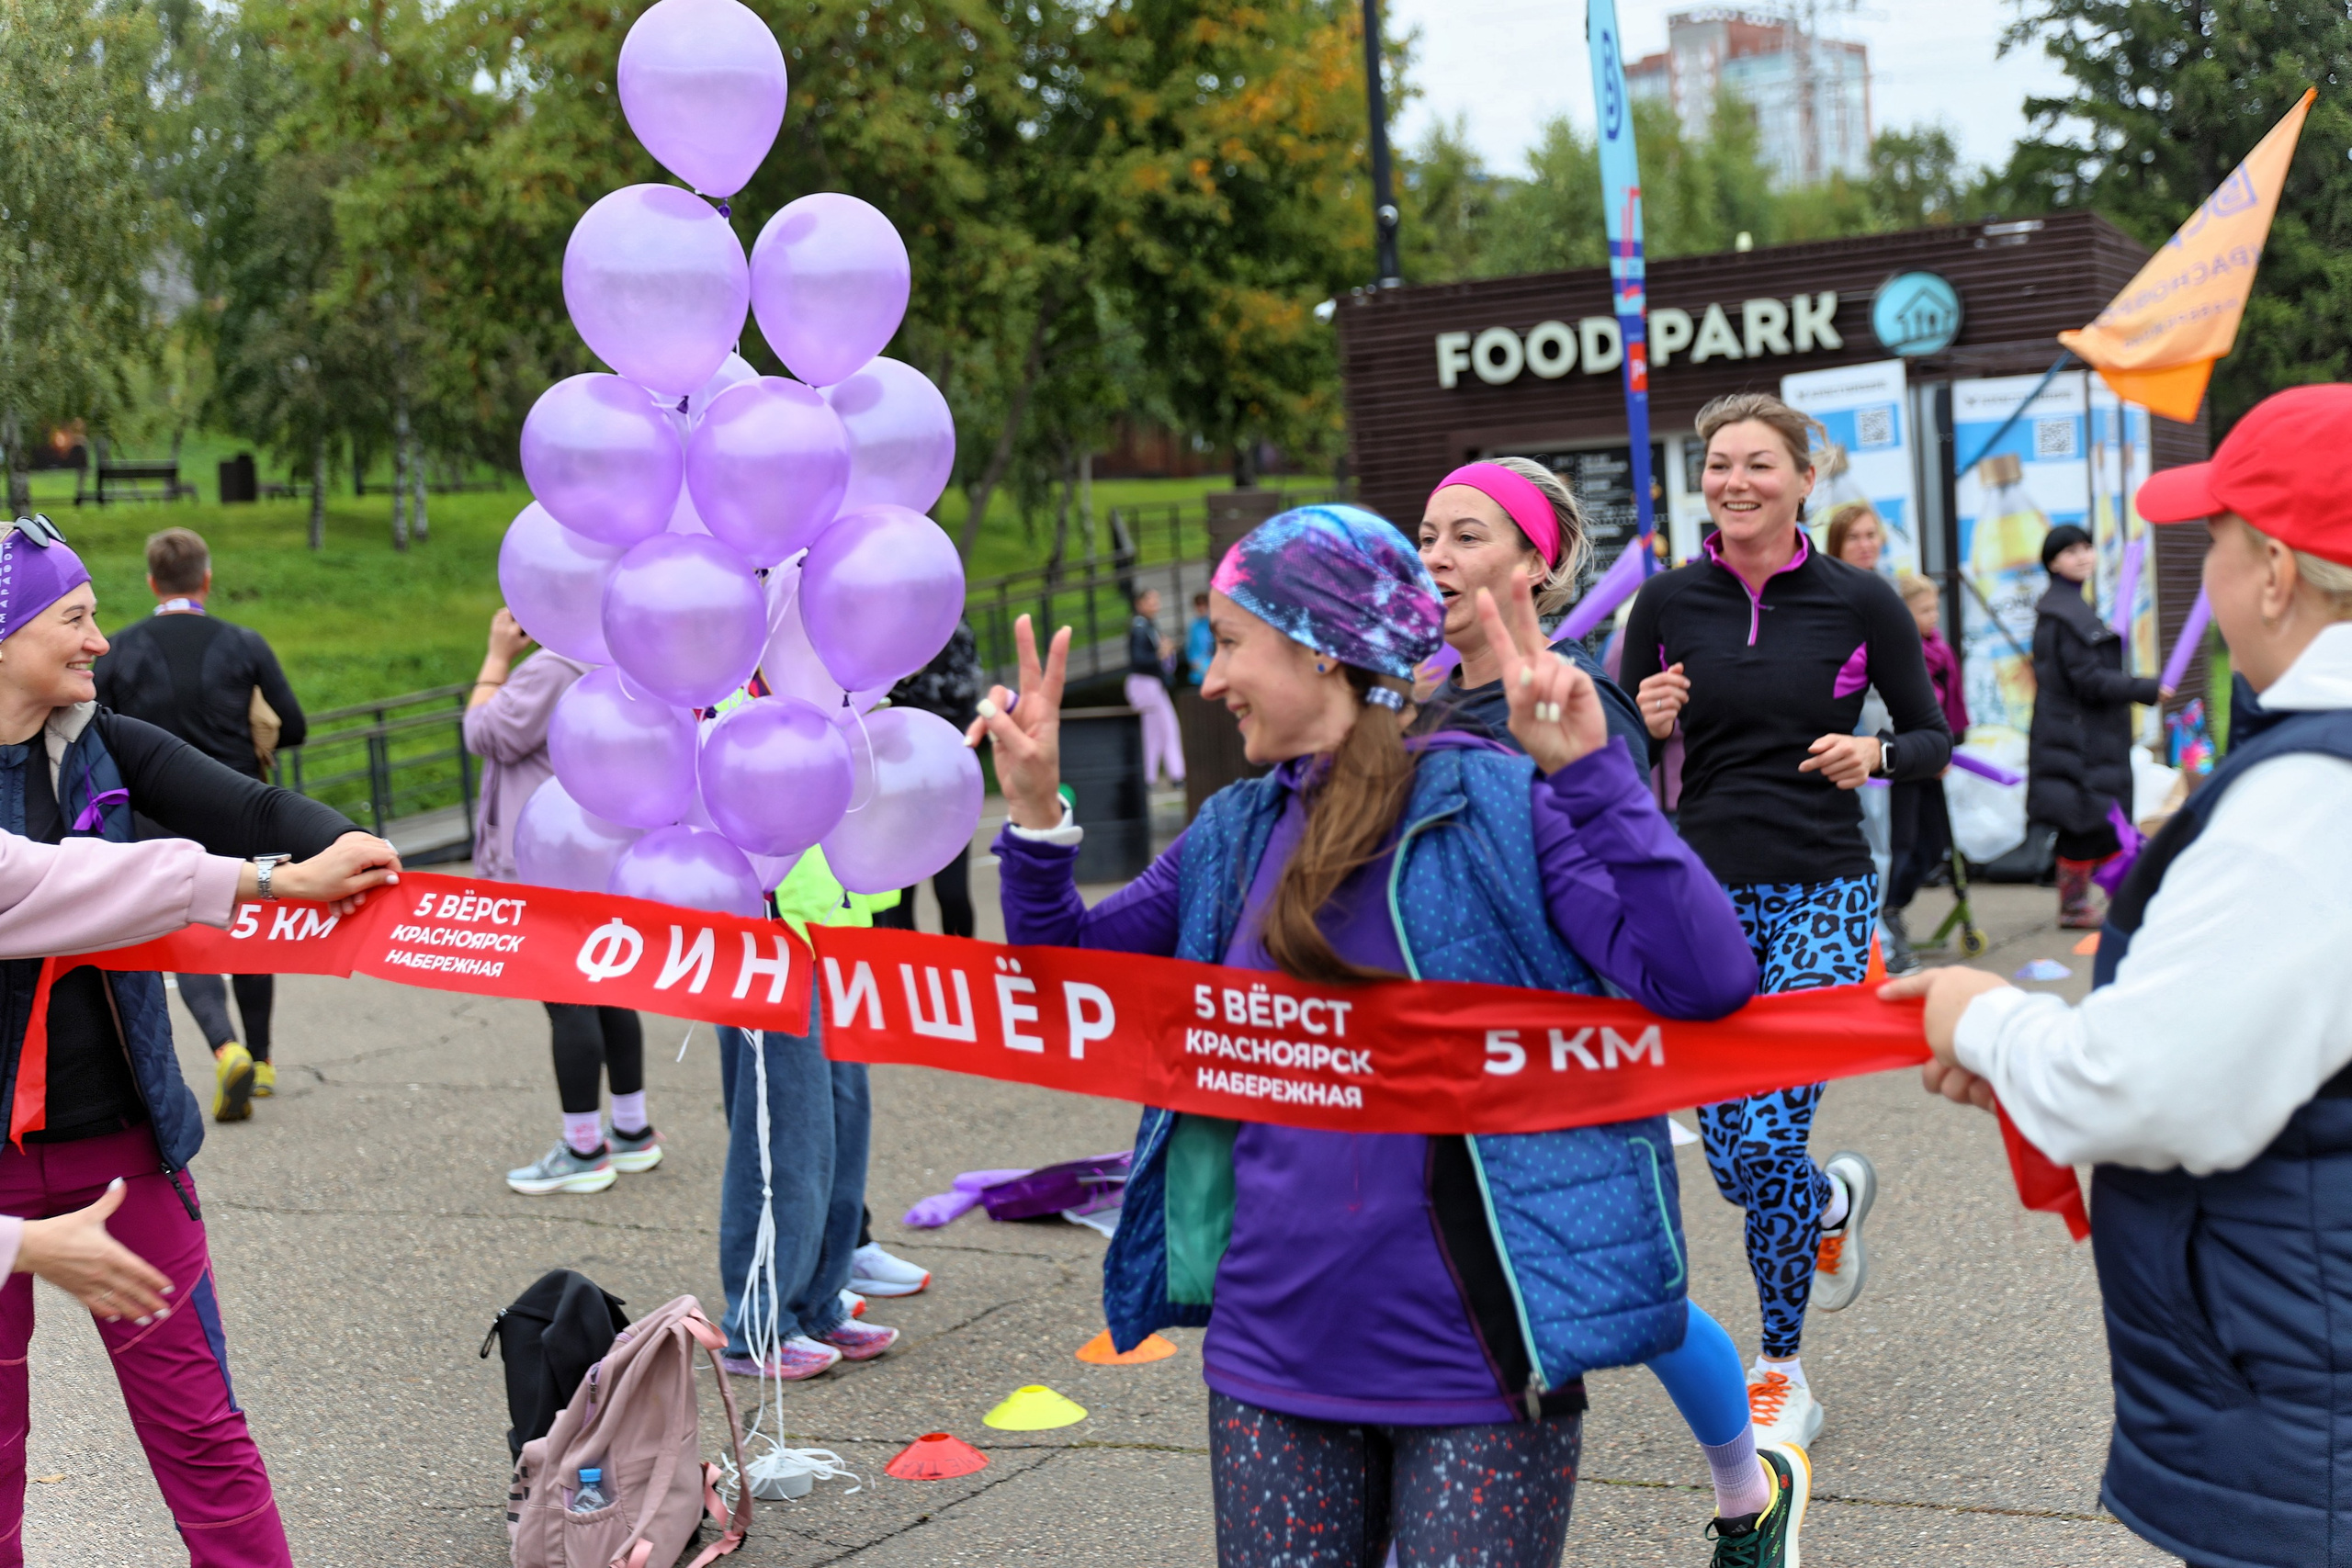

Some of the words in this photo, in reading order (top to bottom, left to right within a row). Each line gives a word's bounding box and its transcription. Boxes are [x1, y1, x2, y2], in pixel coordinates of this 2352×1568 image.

[1435, 315, 1624, 389] FOOD
[1647, 290, 1843, 367] PARK
[231, 904, 262, 939] 5
[267, 907, 339, 941] КМ
[413, 893, 437, 917] 5
[435, 889, 526, 926] ВЁРСТ
[390, 924, 525, 953] КРАСНОЯРСК
[385, 949, 504, 977] НАБЕРЕЖНАЯ
[1195, 984, 1216, 1020] 5
[1222, 982, 1352, 1037] ВЁРСТ
[1185, 1027, 1374, 1075] КРАСНОЯРСК
[1484, 1029, 1527, 1076] 5
[1547, 1024, 1666, 1072] КМ
[1197, 1066, 1363, 1110] НАБЕРЕЖНАЯ
